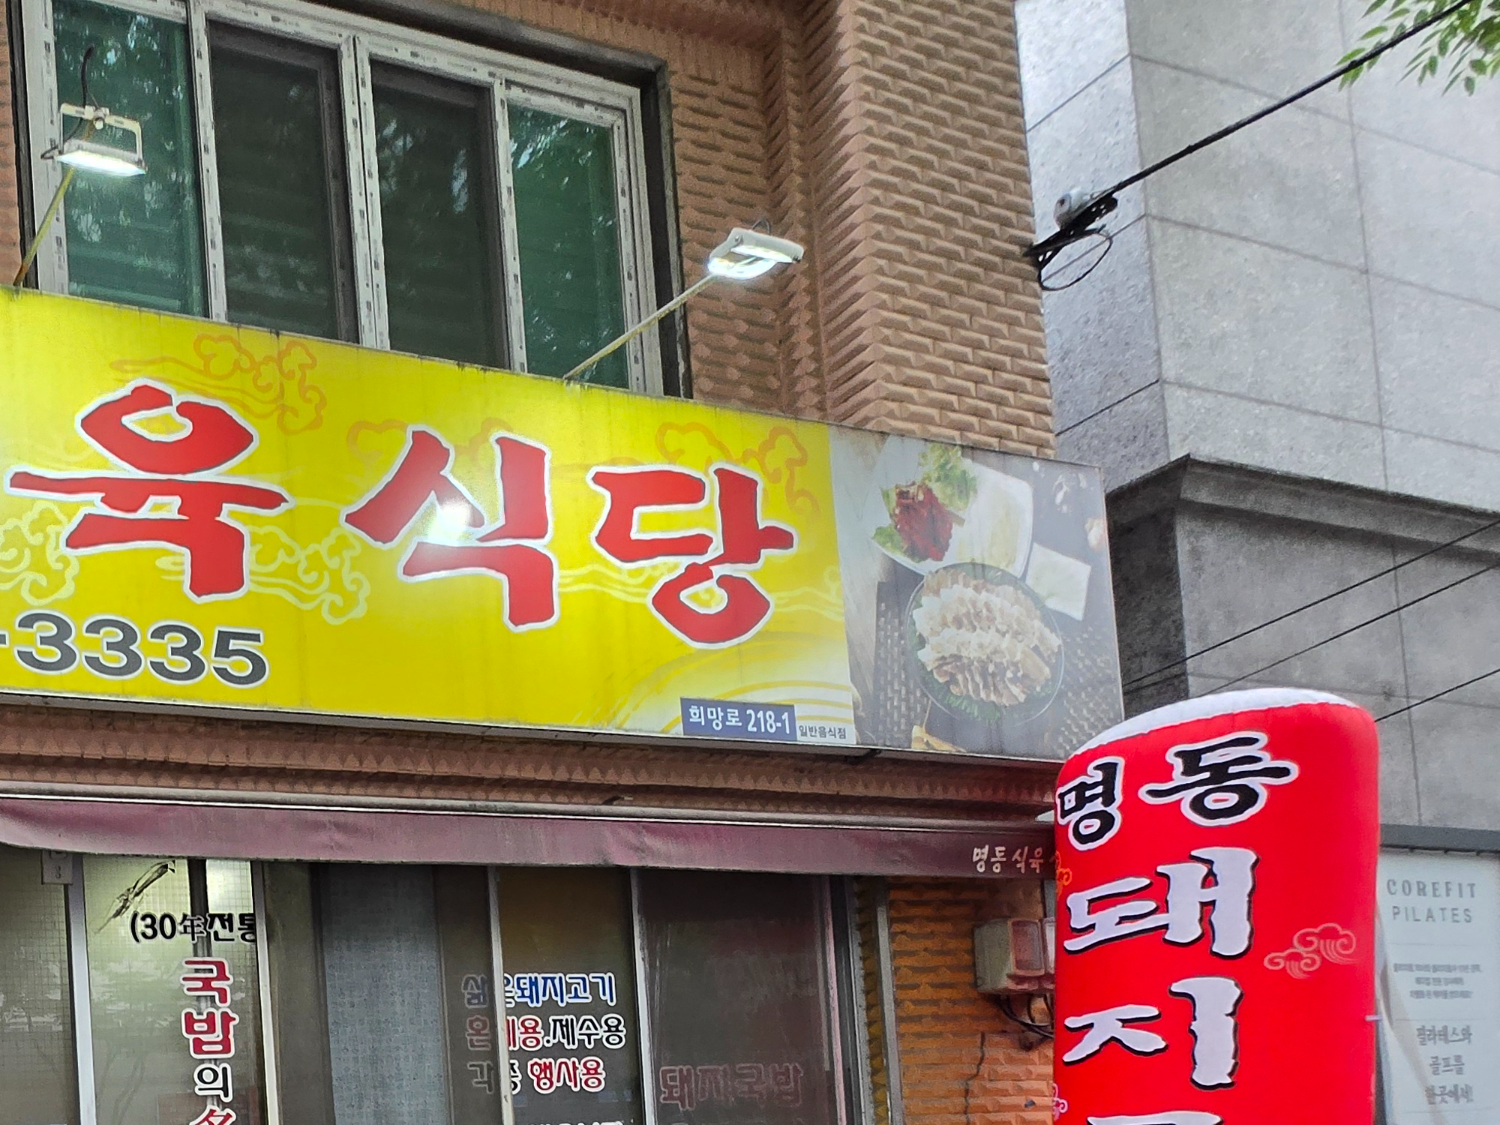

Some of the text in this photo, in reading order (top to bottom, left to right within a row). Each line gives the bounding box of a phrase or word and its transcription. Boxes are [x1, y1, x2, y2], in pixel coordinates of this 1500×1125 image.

[689, 704, 790, 735] 희망로 218-1
[799, 725, 847, 740] 일반음식점
[1054, 731, 1300, 851] 명동
[1386, 878, 1477, 899] COREFIT
[1392, 905, 1473, 924] PILATES
[527, 1056, 607, 1095] 행사용
